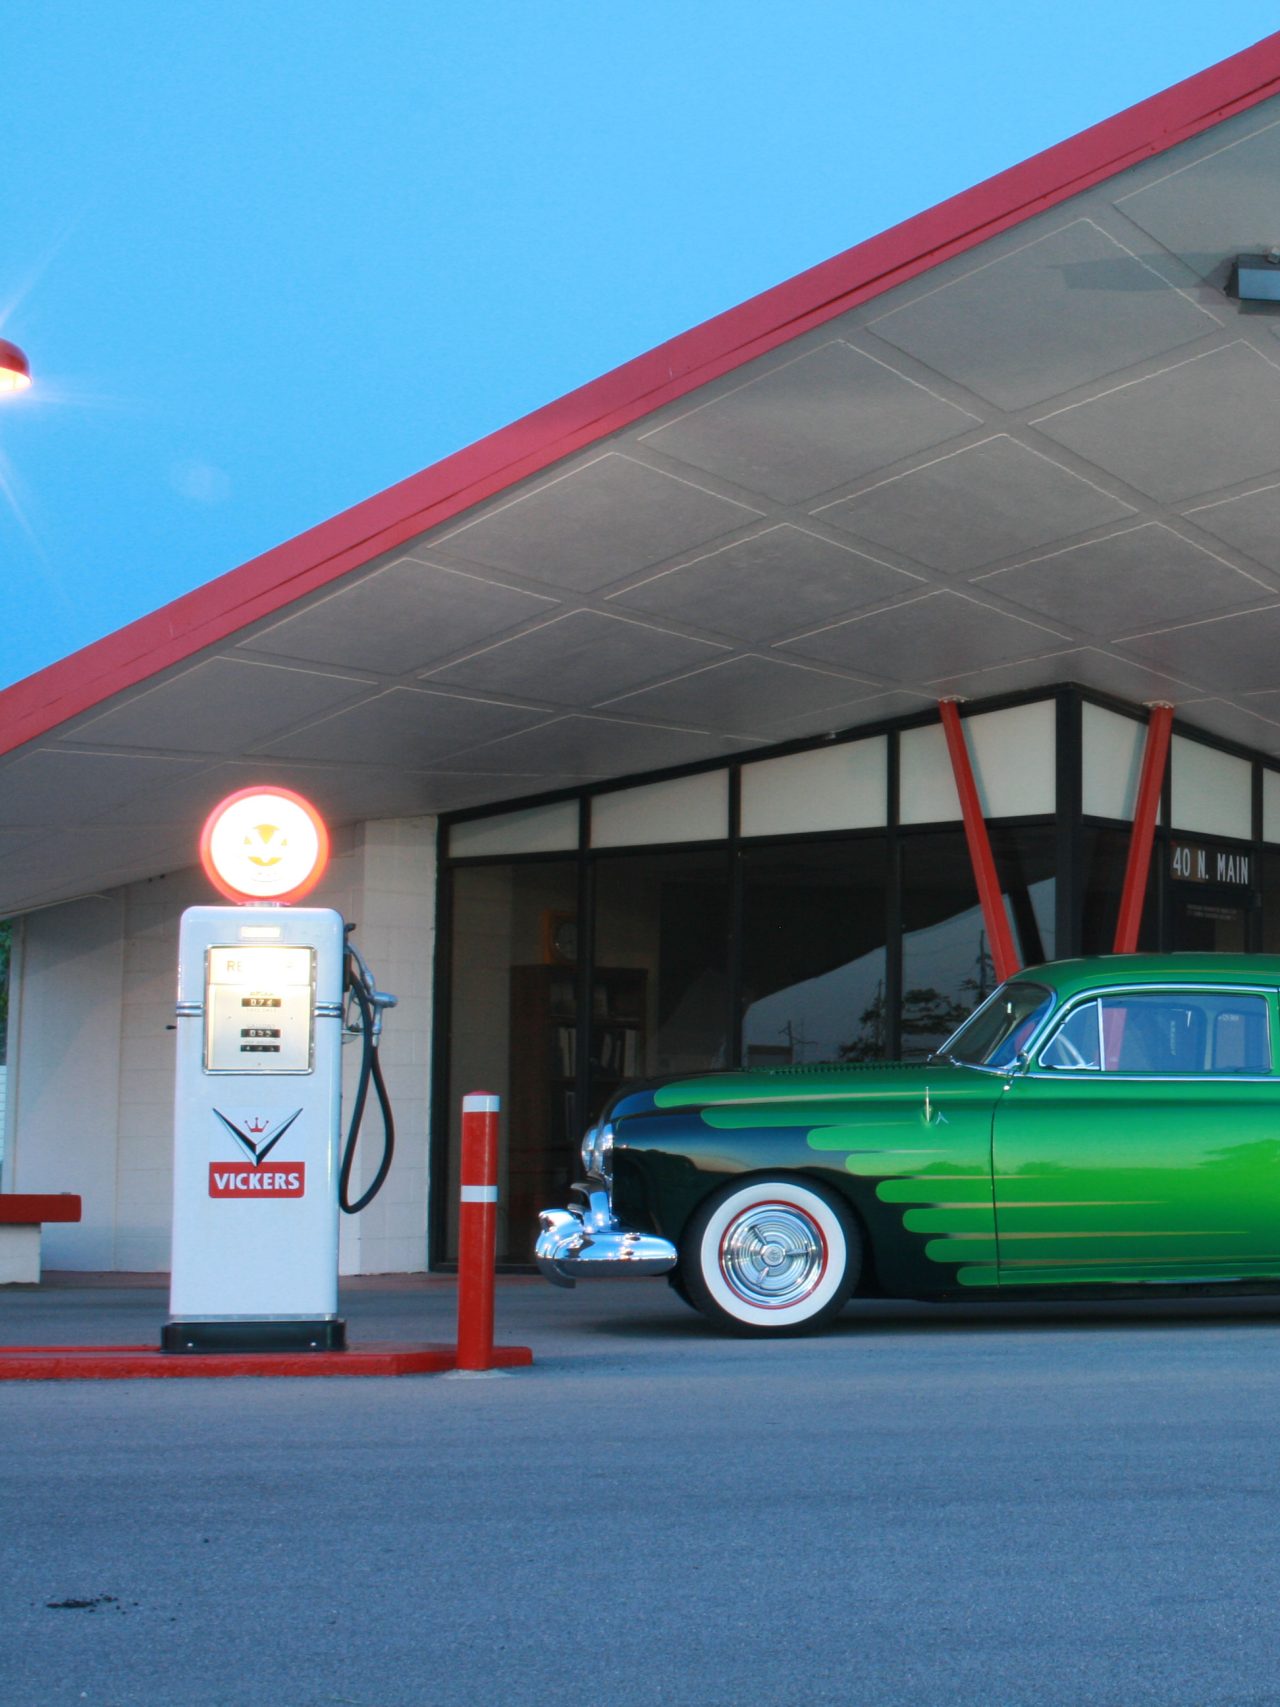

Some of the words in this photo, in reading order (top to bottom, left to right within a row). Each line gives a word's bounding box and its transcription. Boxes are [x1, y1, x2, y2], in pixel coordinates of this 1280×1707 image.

[1173, 847, 1190, 877] 40
[1197, 850, 1209, 879] N.
[1217, 853, 1249, 885] MAIN
[213, 1172, 301, 1190] VICKERS
